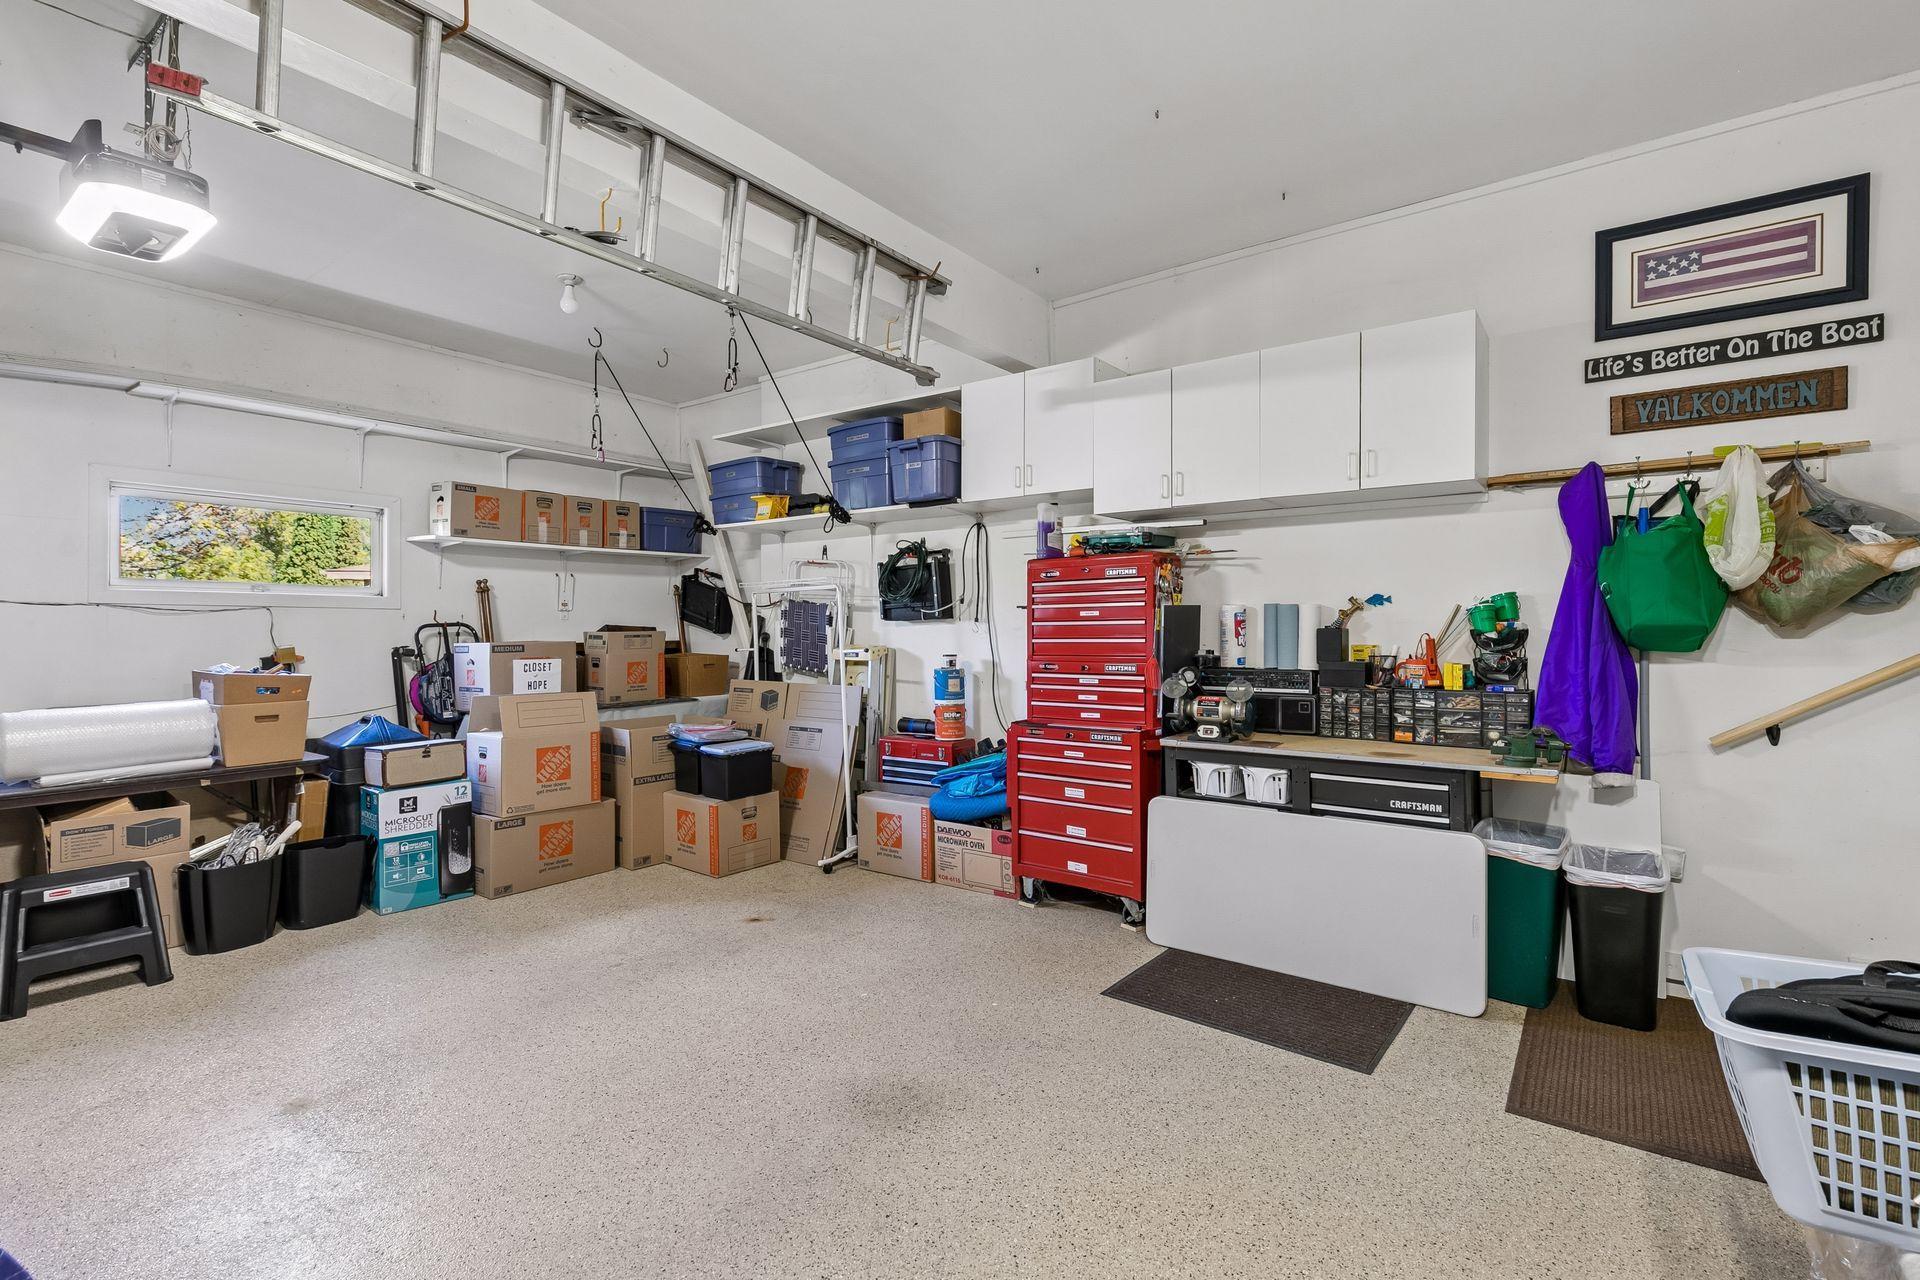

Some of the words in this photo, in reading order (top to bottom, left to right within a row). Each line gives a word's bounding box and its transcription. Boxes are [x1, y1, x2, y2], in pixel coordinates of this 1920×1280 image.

[1587, 354, 1644, 380] Life's
[1651, 344, 1721, 371] Better
[1727, 337, 1759, 358] On
[1766, 329, 1813, 354] The
[1821, 316, 1881, 345] Boat
[1106, 568, 1137, 576] CRAFTSMAN
[523, 662, 552, 673] CLOSET
[527, 680, 548, 691] HOPE
[1091, 734, 1122, 742] CRAFTSMAN
[536, 745, 571, 782] HOME
[541, 751, 554, 765] THE
[550, 758, 571, 781] DEPOT
[635, 776, 656, 785] EXTRA
[454, 786, 468, 796] 12
[1389, 799, 1443, 813] CRAFTSMAN
[385, 813, 434, 827] MICROCUT
[385, 820, 434, 834] SHREDDER
[497, 818, 523, 829] LARGE
[677, 811, 696, 841] HOME
[877, 814, 902, 846] HOME
[937, 826, 971, 838] DAEWOO
[147, 833, 174, 846] LARGE
[540, 822, 572, 859] HOME
[937, 836, 969, 848] MICROWAVE
[969, 841, 985, 850] OVEN
